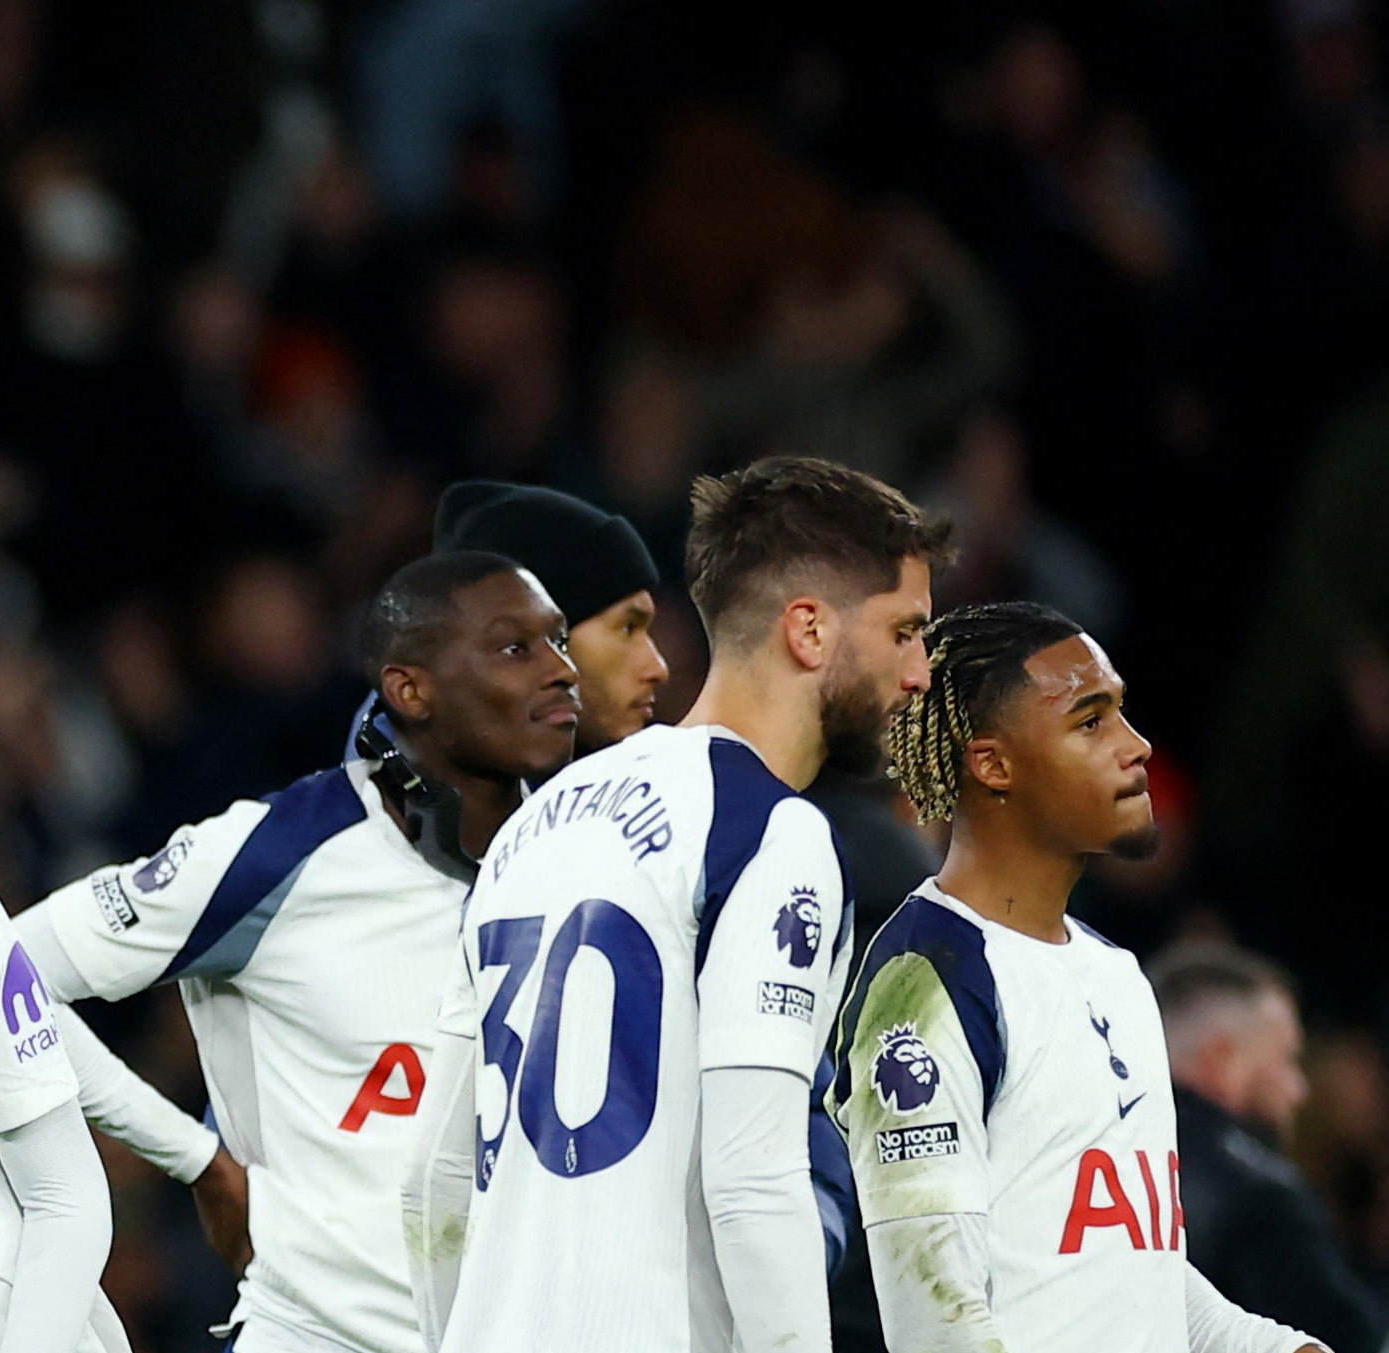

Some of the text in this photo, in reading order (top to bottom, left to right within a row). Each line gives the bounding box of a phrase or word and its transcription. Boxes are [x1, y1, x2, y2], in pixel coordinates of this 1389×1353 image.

[493, 776, 672, 884] BENTANCUR
[476, 898, 664, 1192] 30
[876, 1126, 952, 1149] No room
[878, 1140, 960, 1163] for racism
